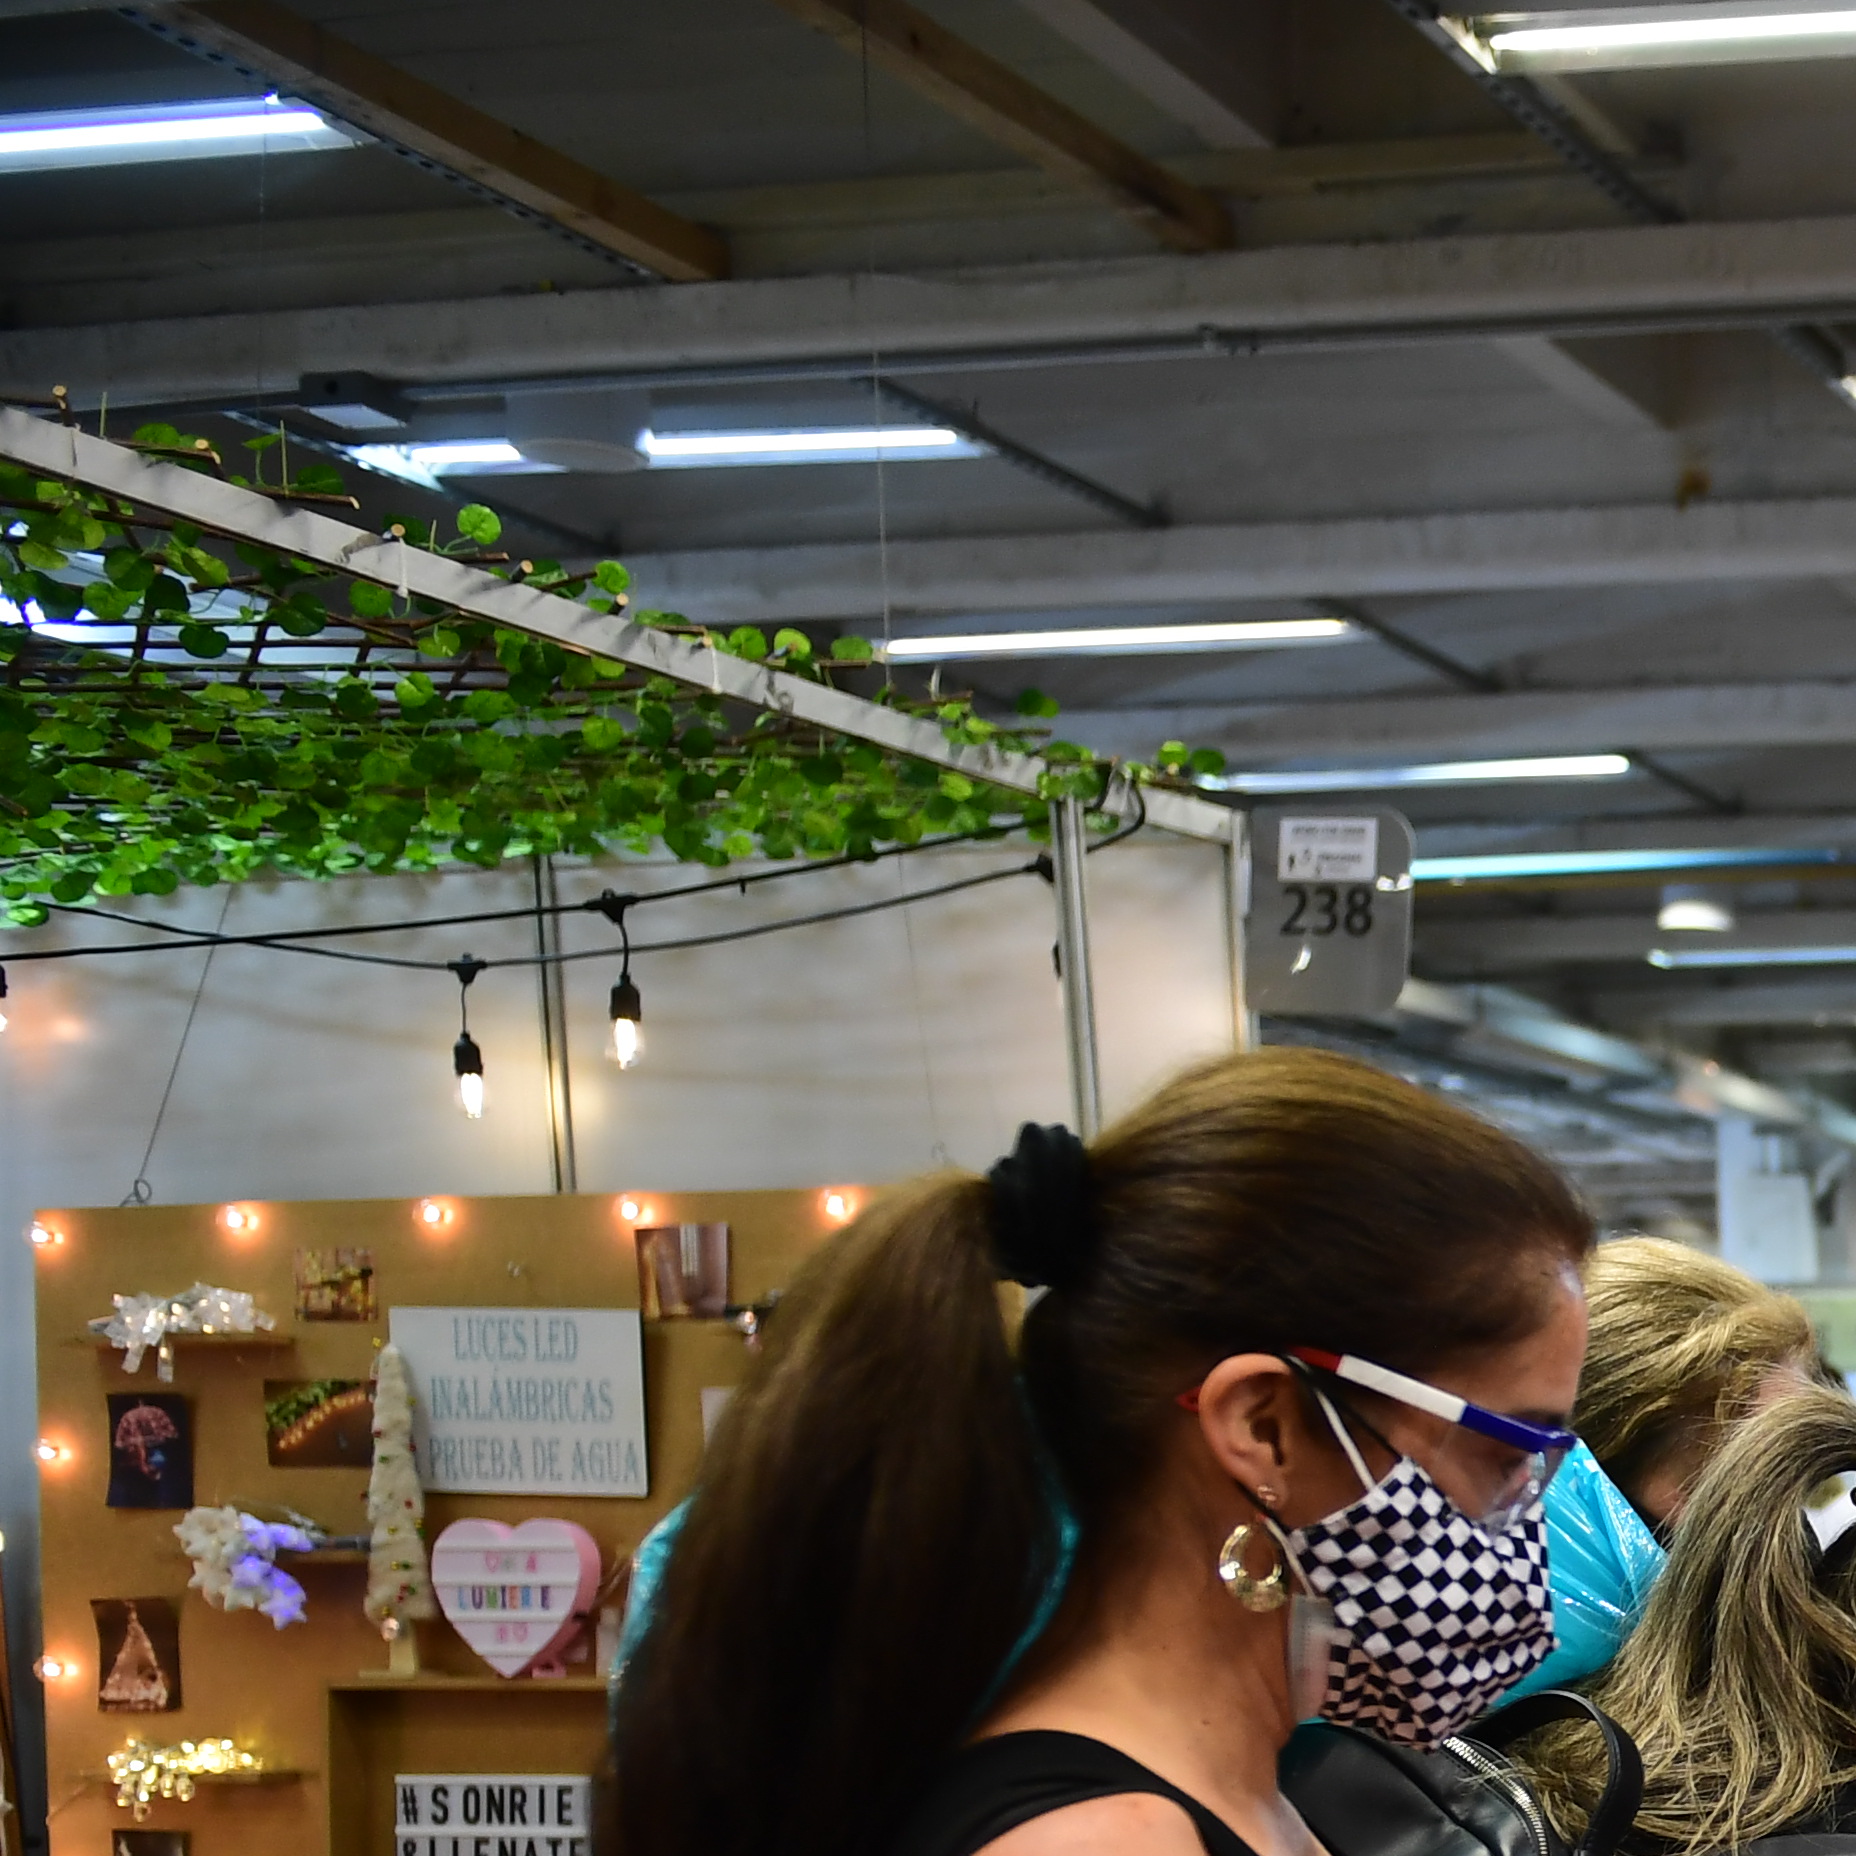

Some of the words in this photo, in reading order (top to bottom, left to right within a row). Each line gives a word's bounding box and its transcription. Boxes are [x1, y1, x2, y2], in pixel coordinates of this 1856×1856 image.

[1281, 884, 1372, 937] 238
[453, 1316, 527, 1362] LUCES
[532, 1317, 579, 1362] LED
[429, 1437, 524, 1481] PRUEBA
[532, 1438, 564, 1481] DE
[572, 1439, 639, 1484] AGUA
